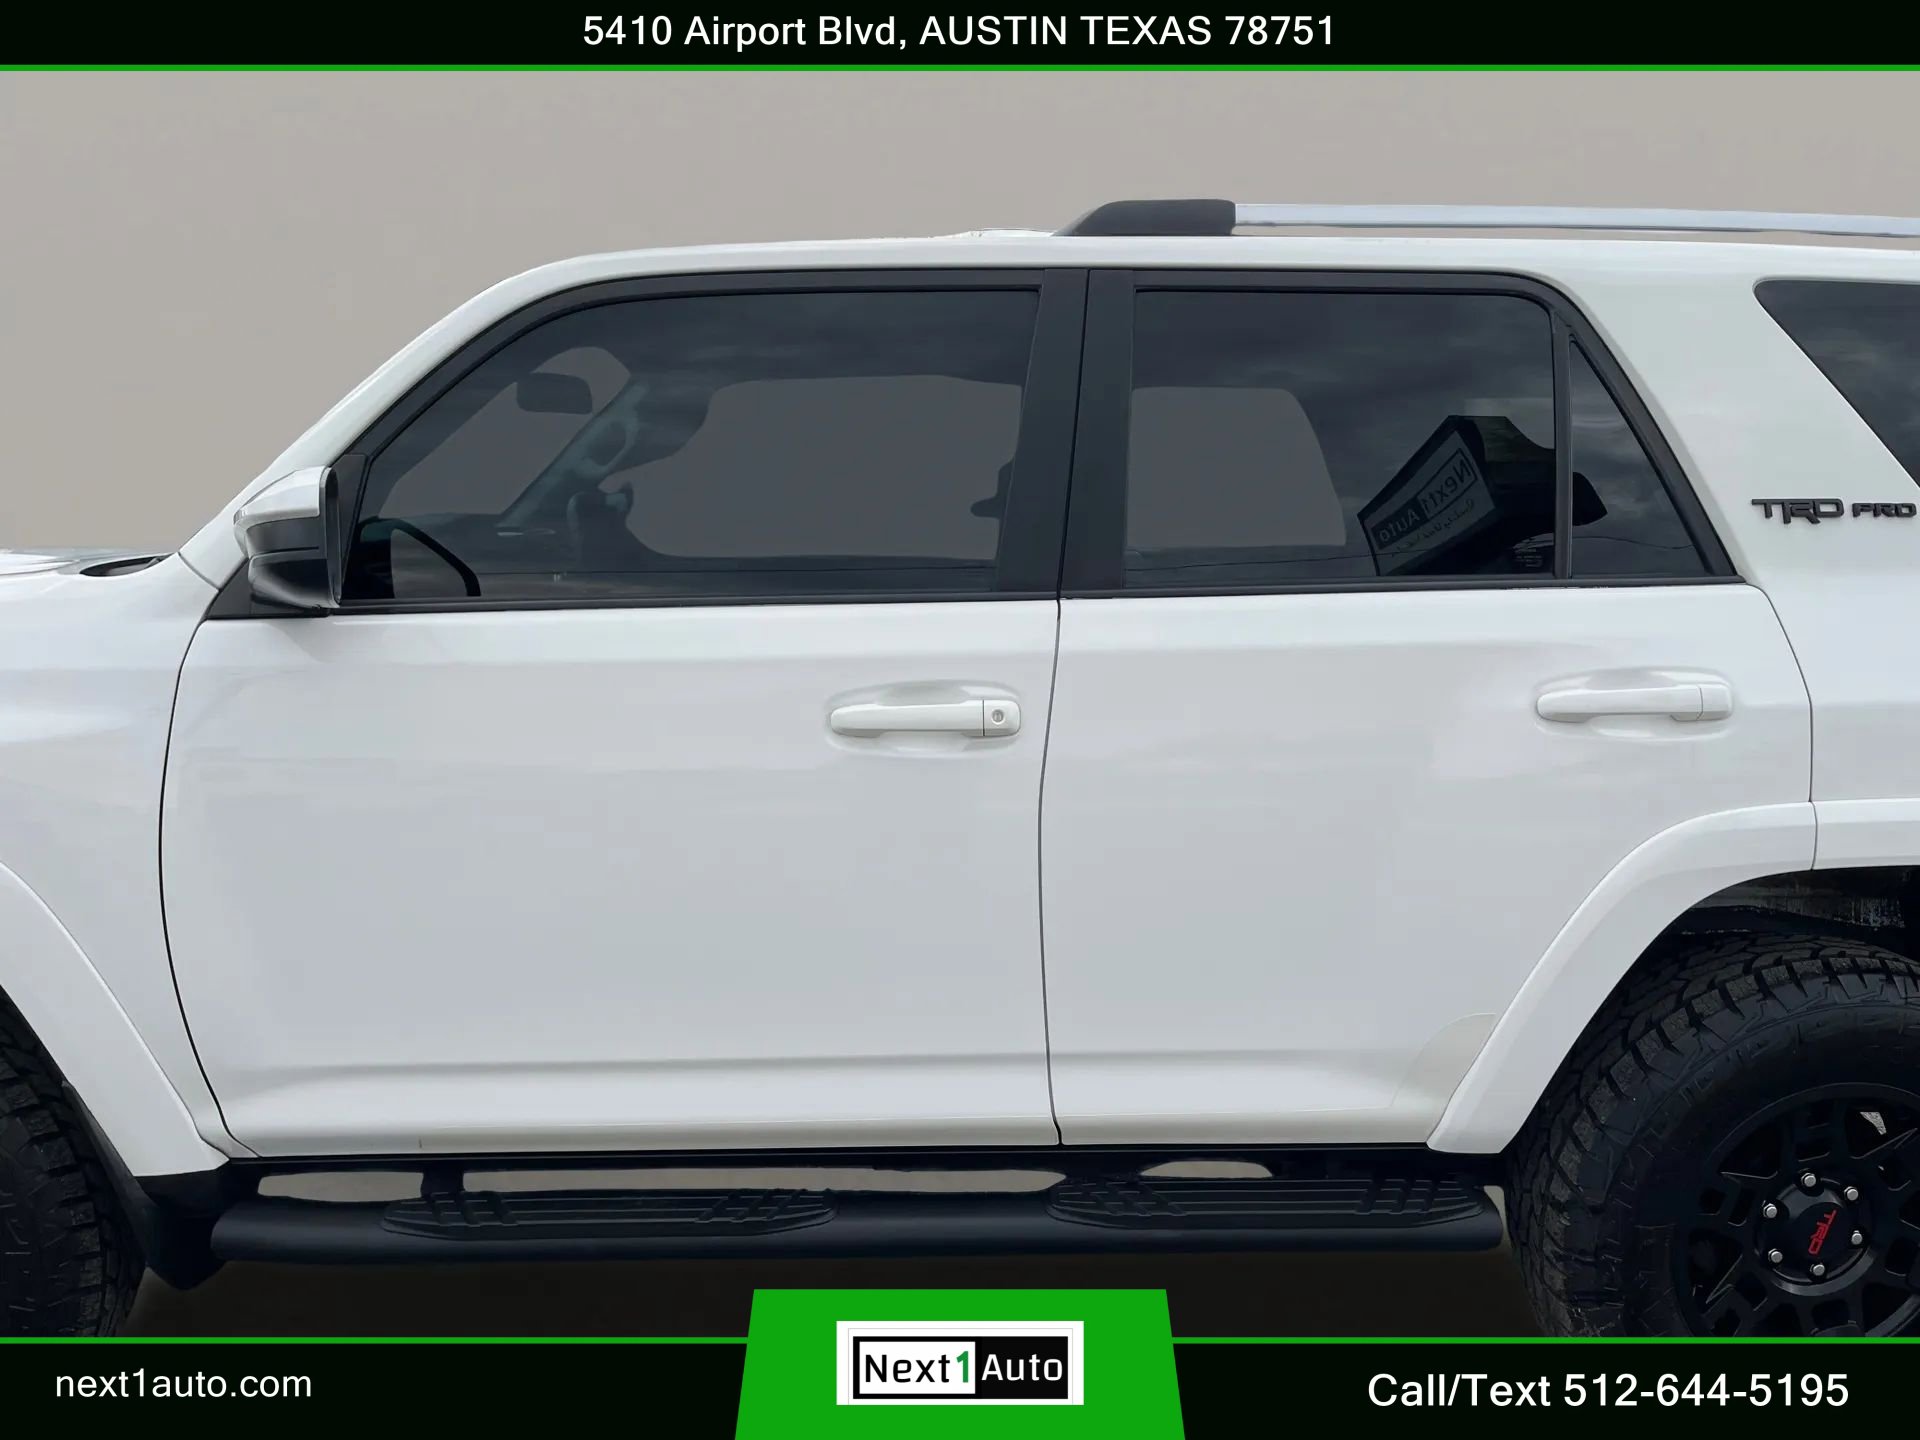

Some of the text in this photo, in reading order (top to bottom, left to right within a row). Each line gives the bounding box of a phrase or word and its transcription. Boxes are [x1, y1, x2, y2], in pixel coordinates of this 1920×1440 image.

[1751, 498, 1917, 525] TRD PRO
[1808, 1209, 1837, 1255] TRD
